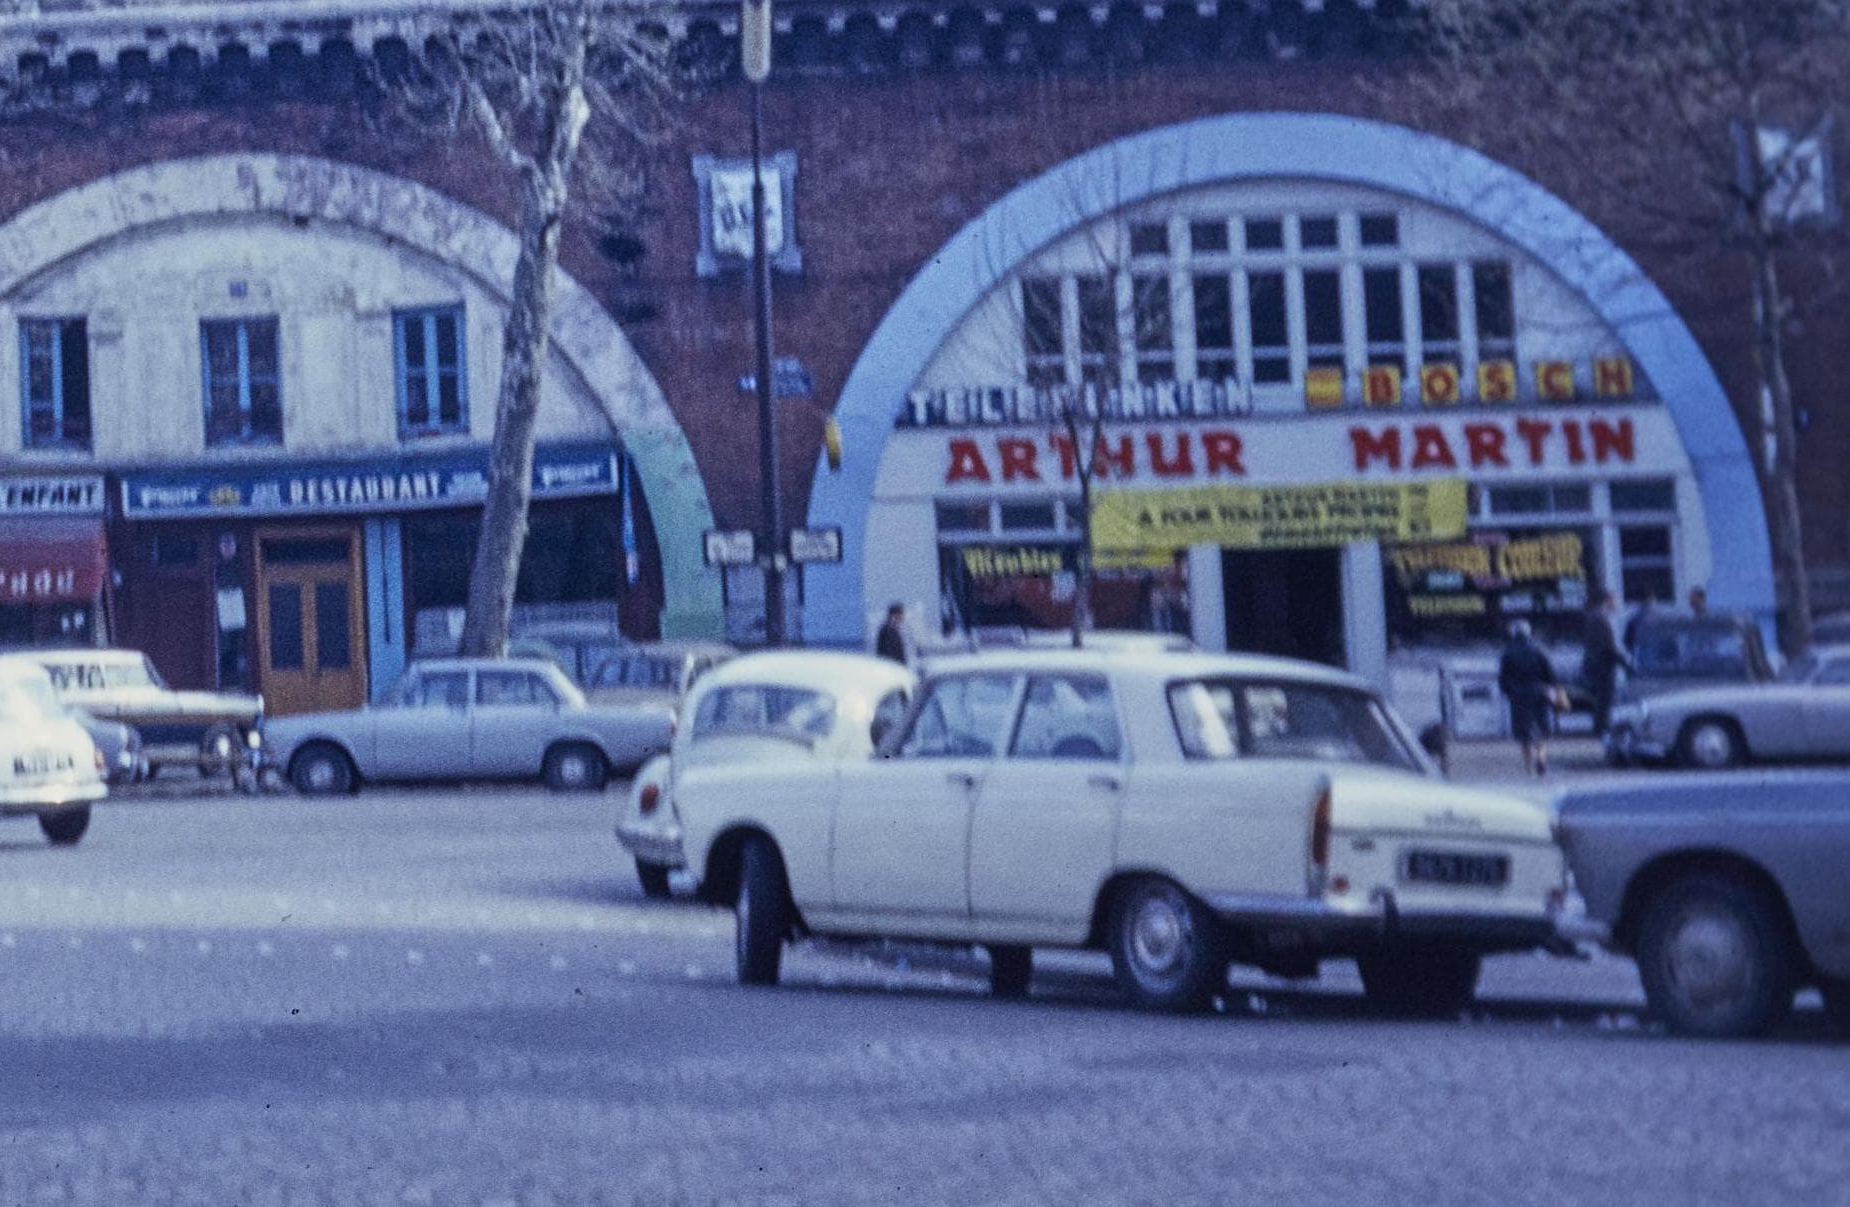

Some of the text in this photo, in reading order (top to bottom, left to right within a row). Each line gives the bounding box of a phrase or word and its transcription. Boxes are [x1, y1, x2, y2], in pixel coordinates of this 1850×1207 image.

[1368, 358, 1629, 404] BOSCH
[946, 416, 1634, 483] ARTHUR MARTIN
[290, 471, 440, 505] RESTAURANT
